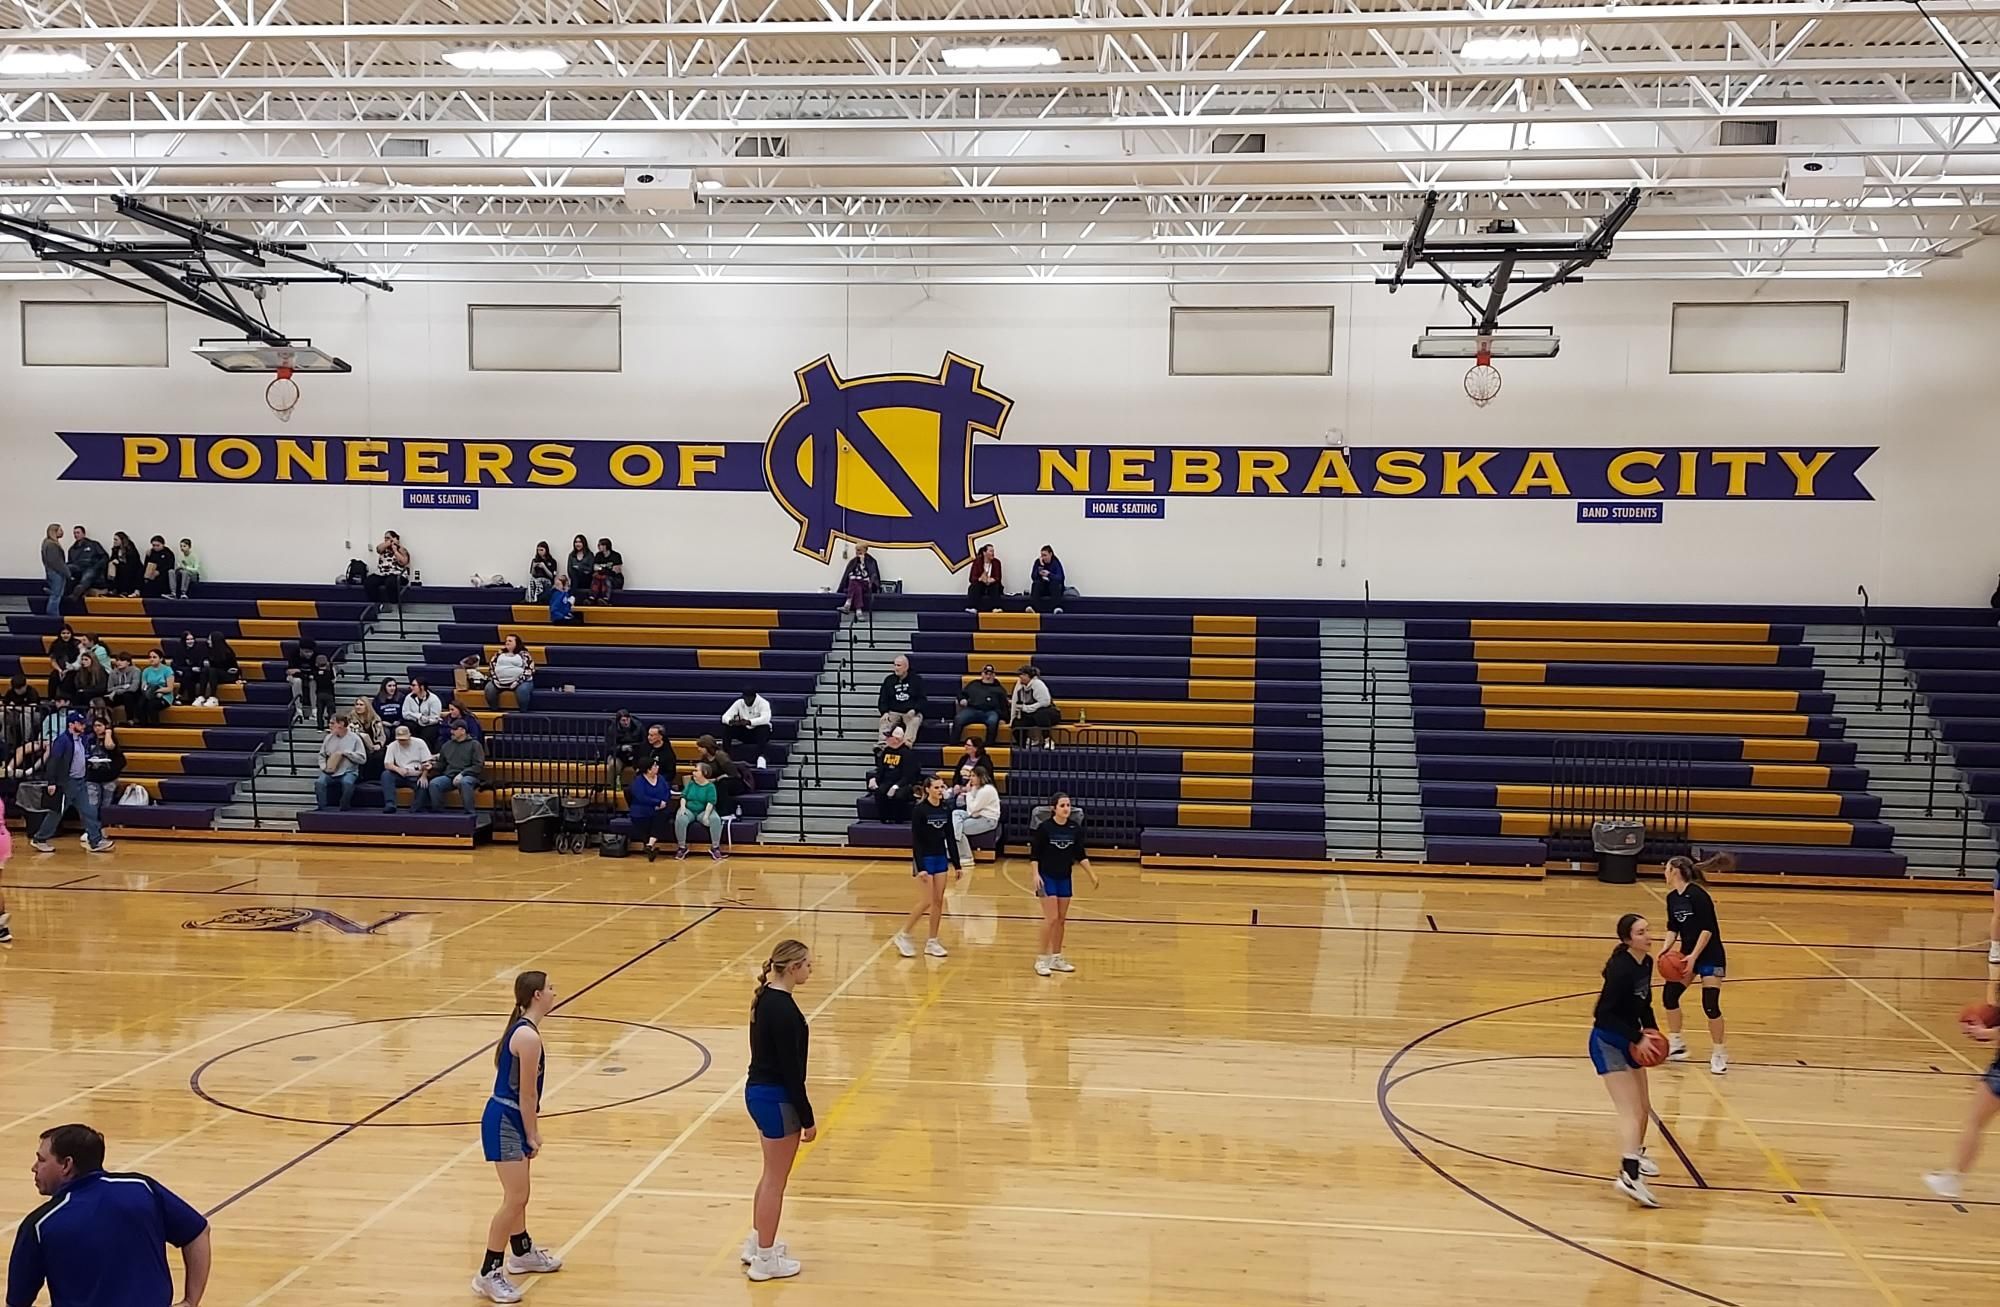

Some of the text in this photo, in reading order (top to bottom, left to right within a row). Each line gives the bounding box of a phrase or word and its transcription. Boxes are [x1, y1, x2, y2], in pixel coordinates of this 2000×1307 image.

[122, 437, 1836, 496] PIONEERS OF NEBRASKA CITY
[409, 493, 472, 505] HOME SEATING
[1092, 503, 1158, 514] HOME SEATING
[1582, 507, 1658, 518] BAND STUDENTS
